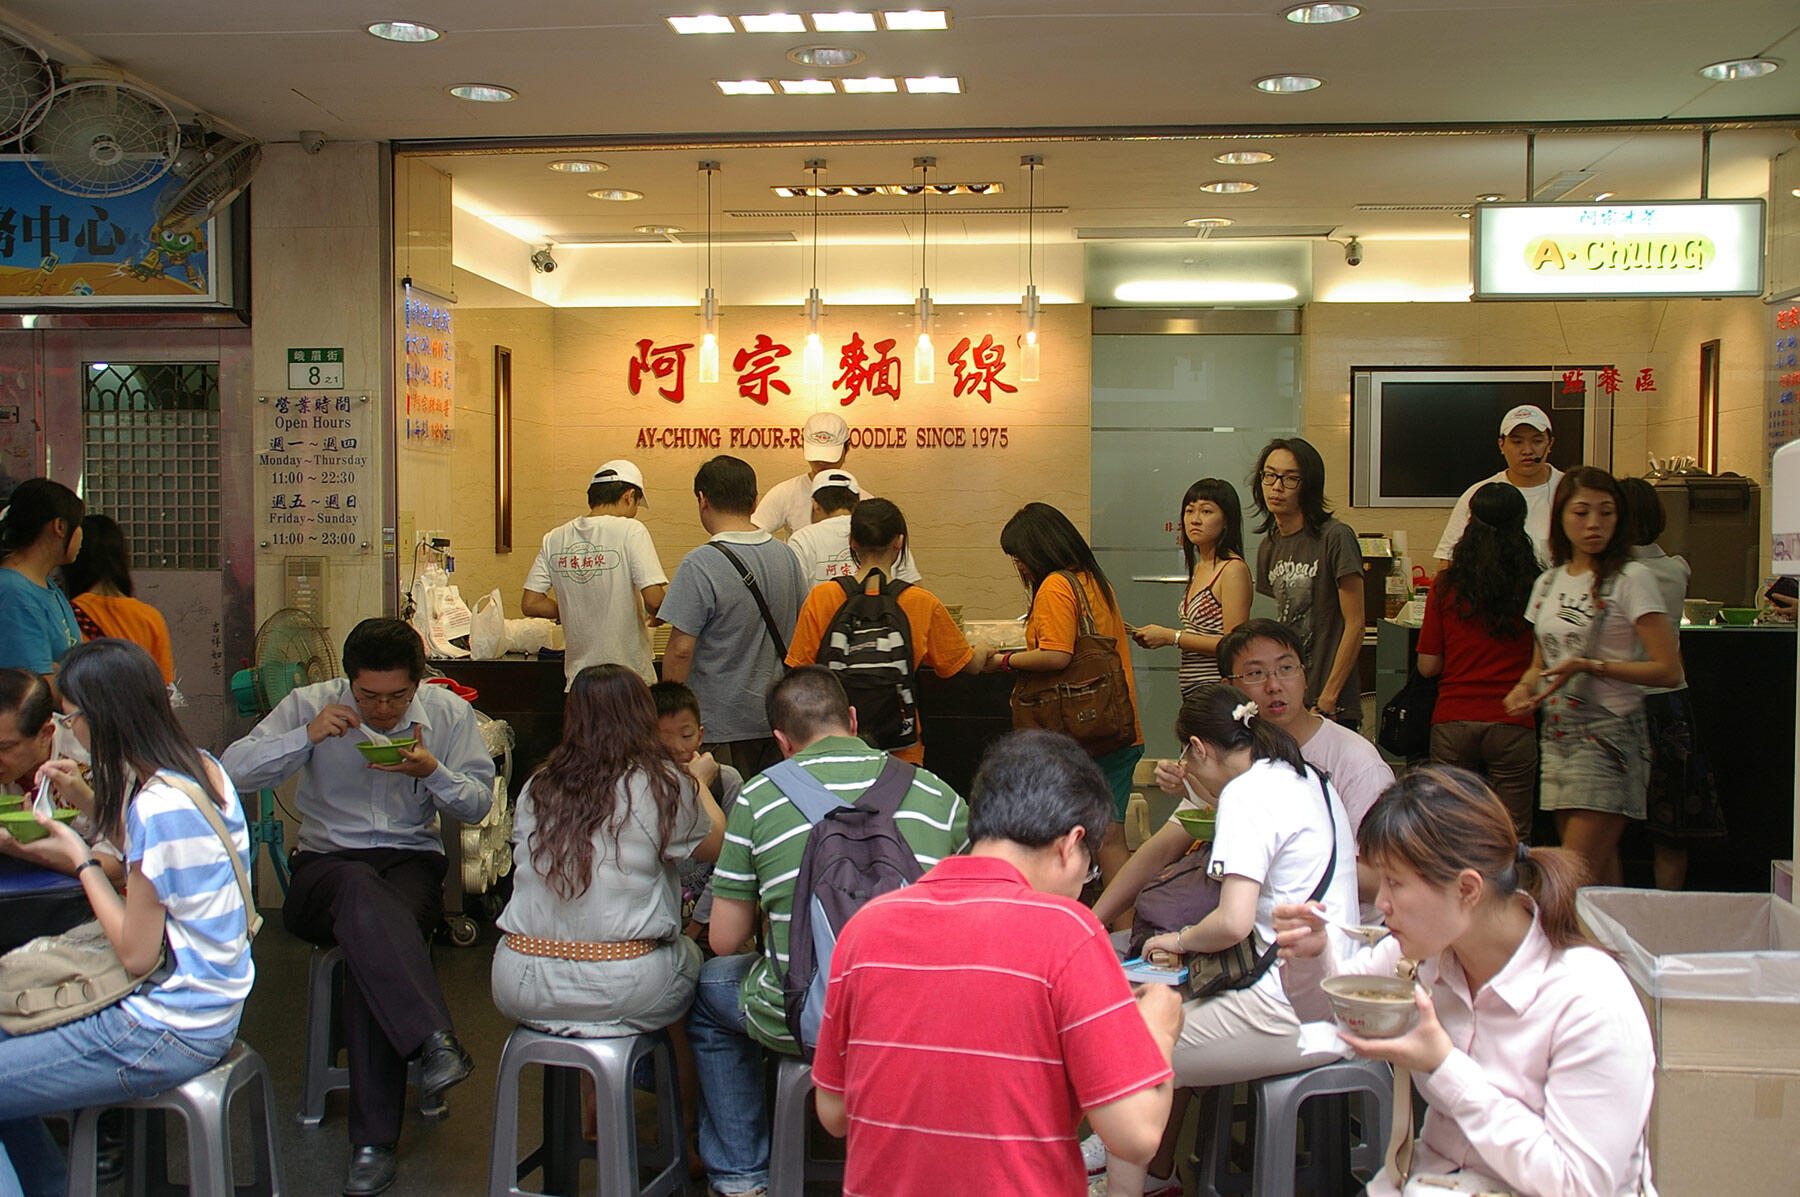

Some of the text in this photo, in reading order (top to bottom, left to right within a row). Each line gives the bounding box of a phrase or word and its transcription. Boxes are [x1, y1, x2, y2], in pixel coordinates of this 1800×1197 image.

[309, 366, 320, 385] 8
[628, 331, 1018, 406] 阿宗麵線
[1562, 366, 1657, 395] 點餐區
[275, 396, 351, 414] 營業時間
[275, 416, 351, 432] Open Hours
[636, 427, 1009, 449] AY-CHUNG FLOUR-R OODLE SINCE 1975
[272, 472, 304, 484] 11:00
[321, 472, 355, 484] 22:30
[272, 533, 304, 545] 11:00
[321, 533, 356, 545] 23:00
